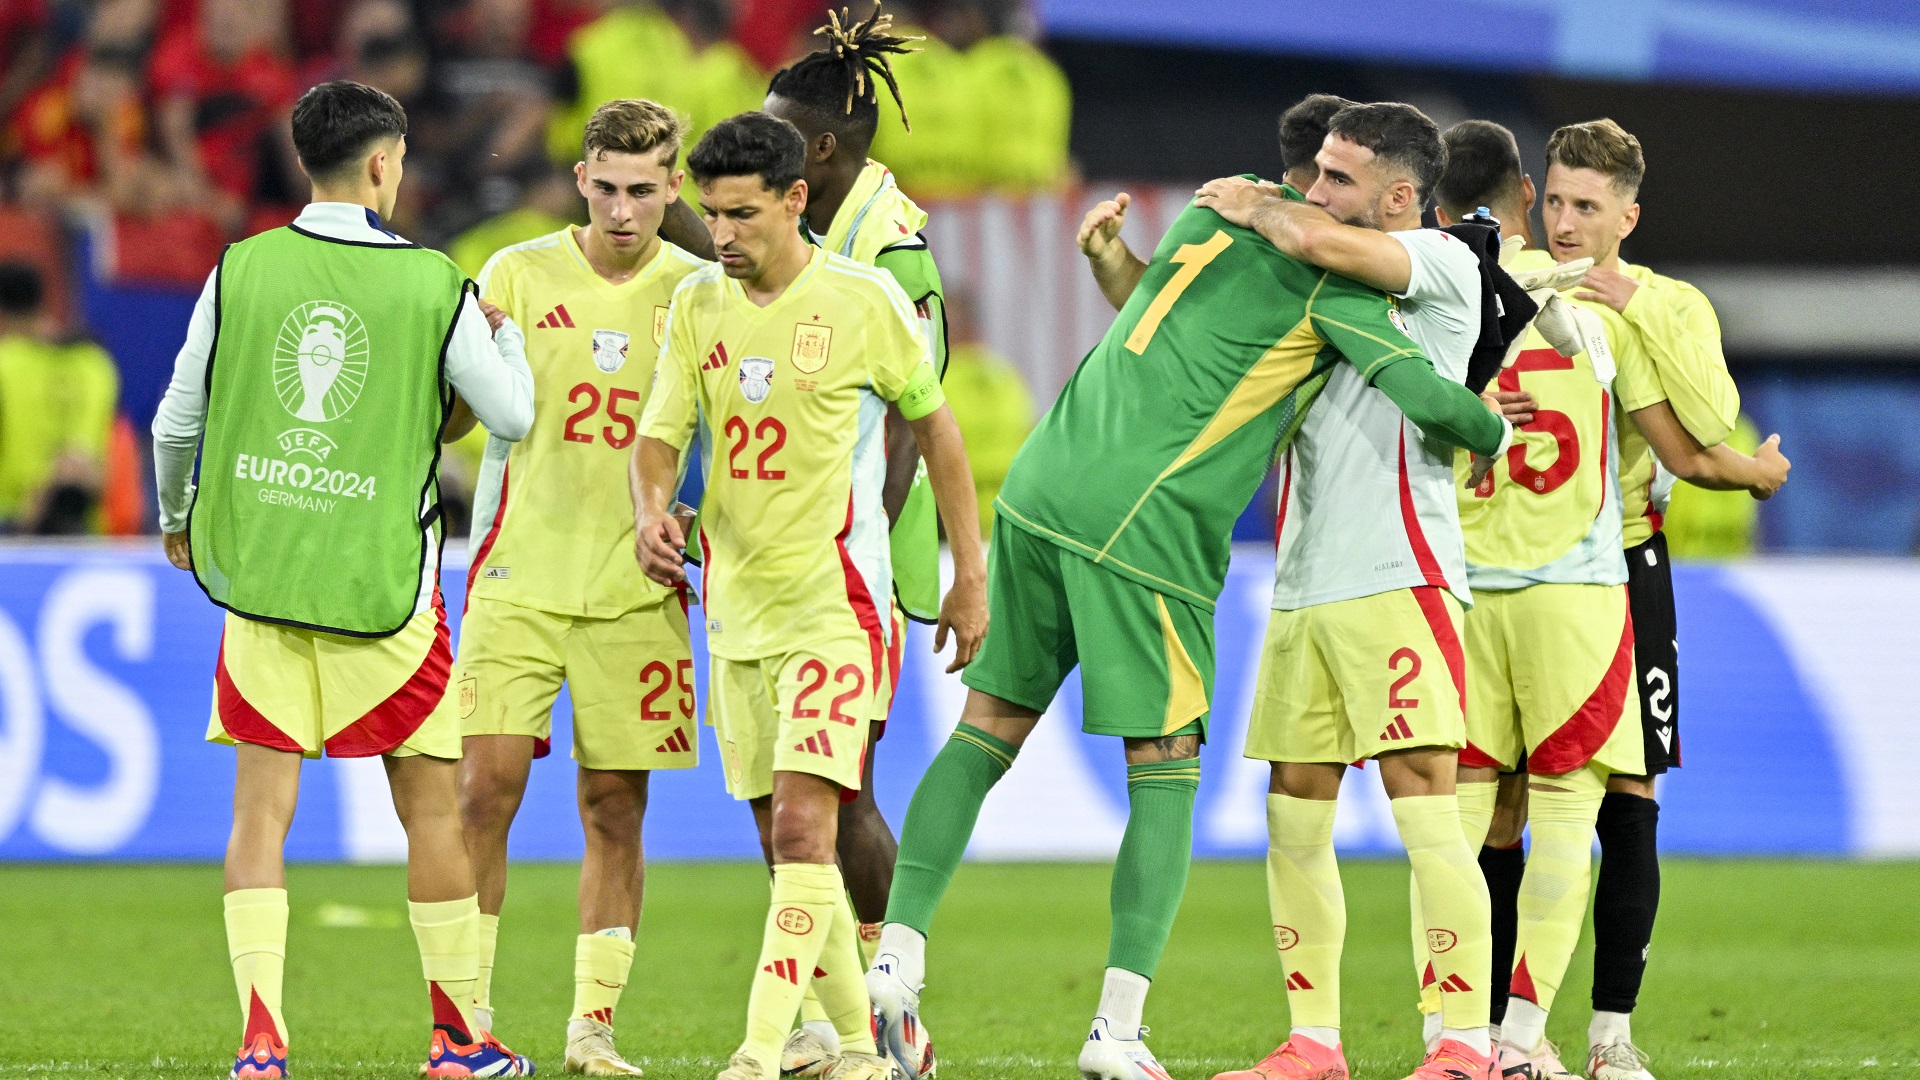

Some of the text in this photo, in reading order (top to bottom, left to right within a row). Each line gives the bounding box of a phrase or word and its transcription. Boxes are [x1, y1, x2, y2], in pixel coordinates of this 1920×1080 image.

[1124, 229, 1235, 356] 1
[279, 433, 331, 460] UEFA
[563, 382, 640, 450] 25
[724, 415, 787, 480] 22
[258, 488, 337, 514] GERMANY
[639, 659, 696, 721] 25
[792, 658, 865, 727] 22
[1388, 646, 1422, 709] 2
[1646, 666, 1672, 723] 2
